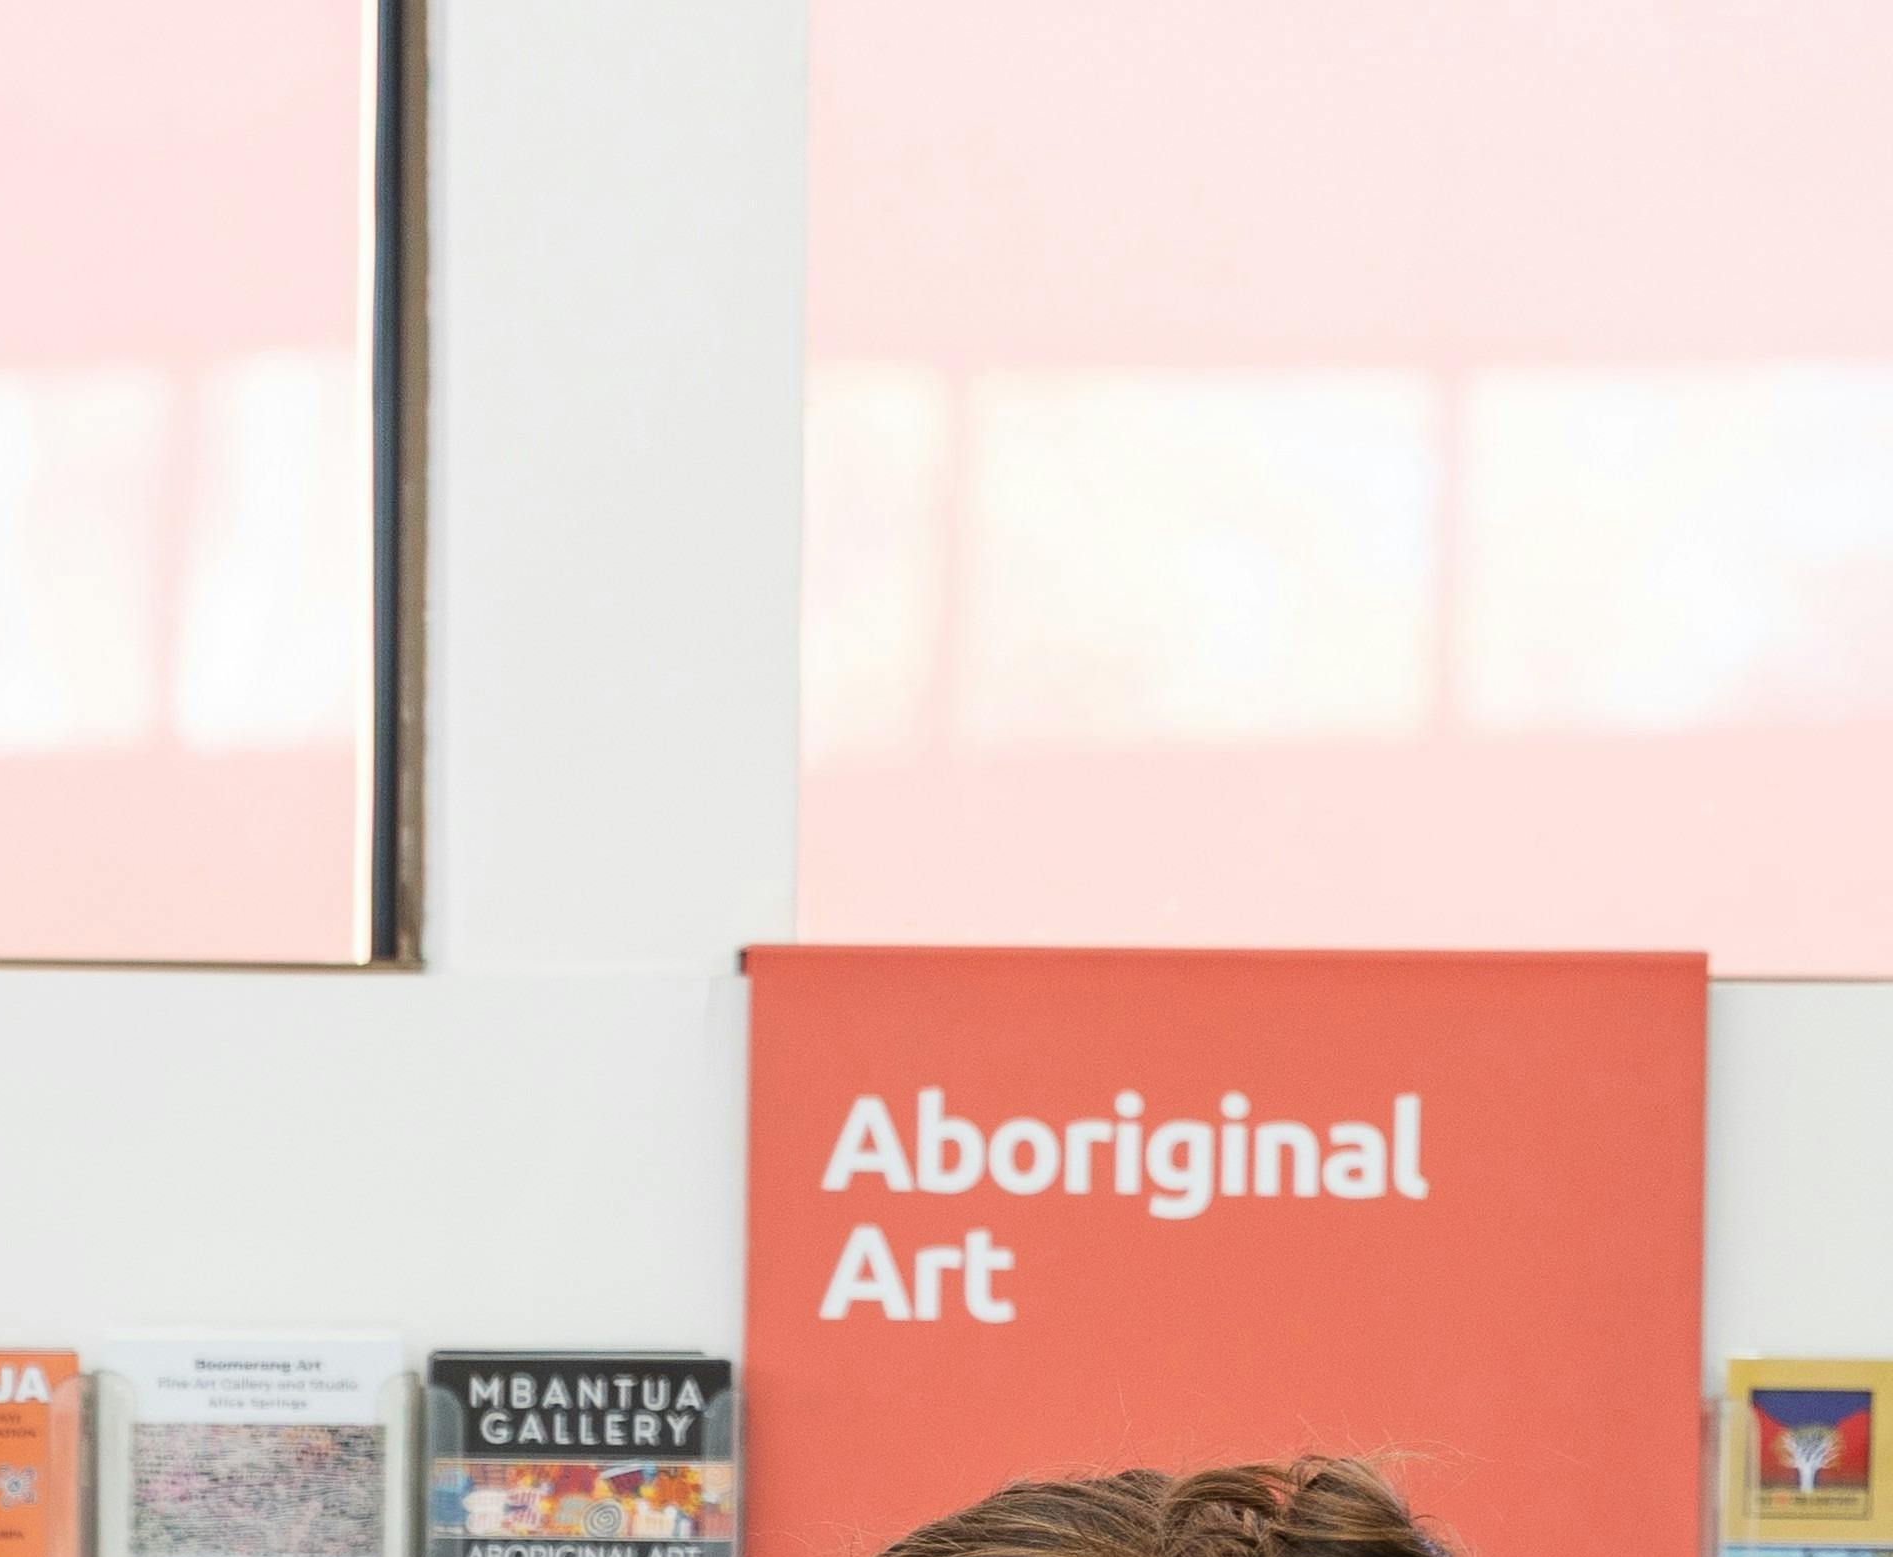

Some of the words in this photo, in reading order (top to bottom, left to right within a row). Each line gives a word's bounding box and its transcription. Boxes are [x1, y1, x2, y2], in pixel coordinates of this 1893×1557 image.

[822, 1087, 1428, 1220] Aboriginal
[820, 1225, 1015, 1324] Art
[469, 1375, 705, 1412] MBANTUA
[480, 1410, 691, 1446] GALLERY
